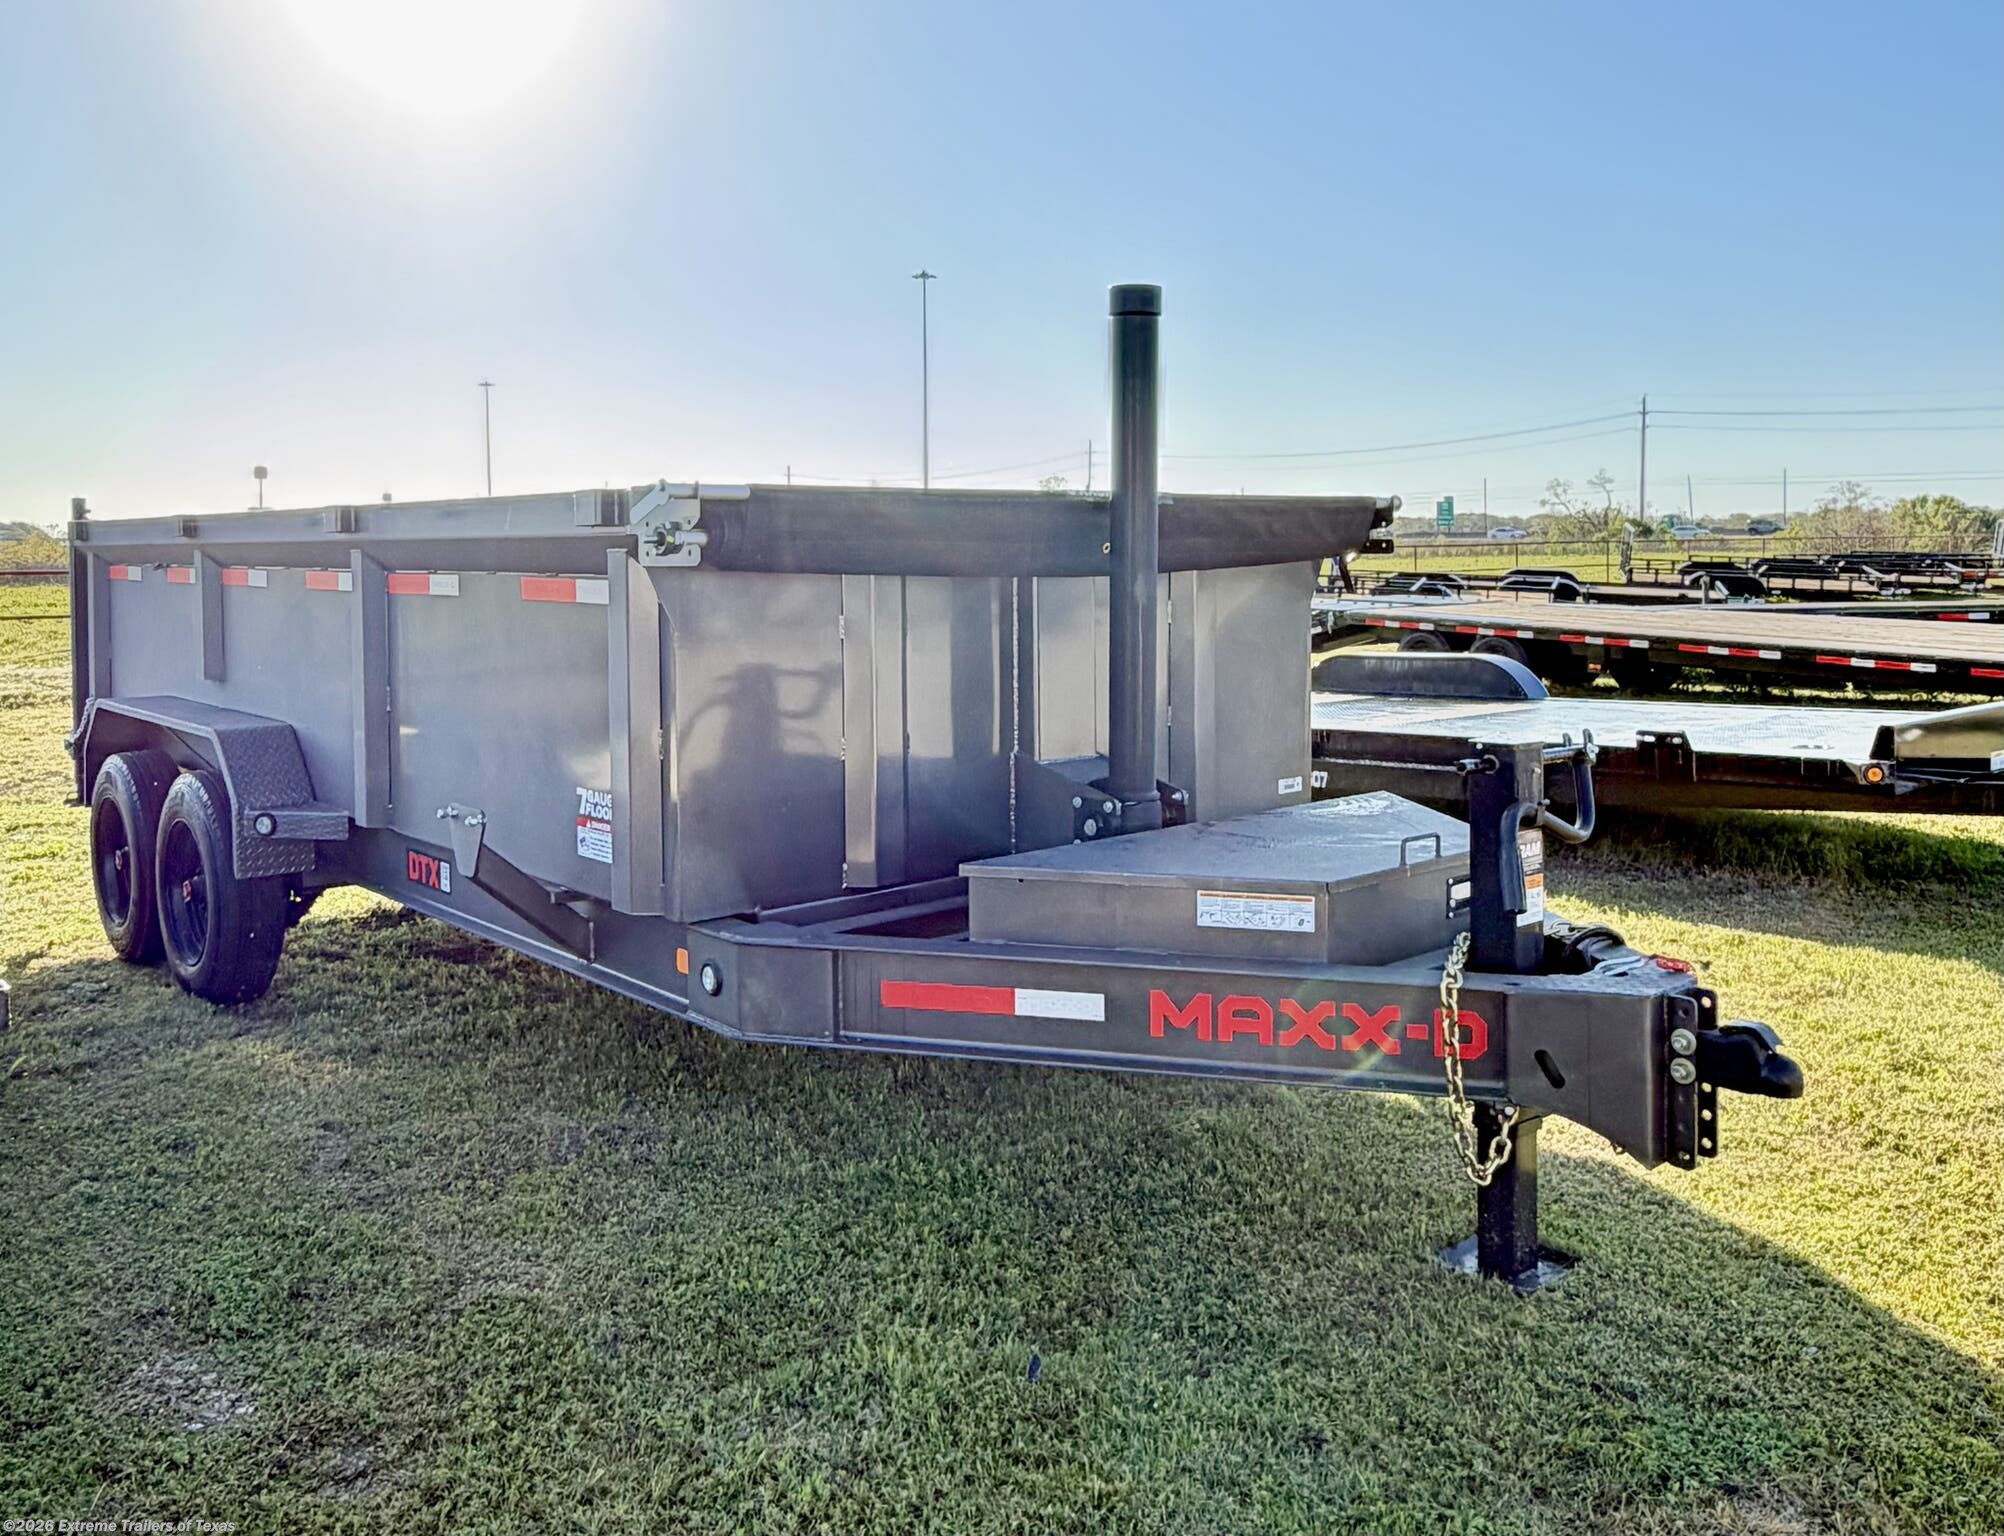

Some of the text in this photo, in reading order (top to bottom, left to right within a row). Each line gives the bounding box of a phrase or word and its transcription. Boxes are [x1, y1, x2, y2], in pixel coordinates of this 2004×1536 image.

[576, 787, 612, 815] 7 GAUG
[408, 850, 439, 889] DTX
[1149, 989, 1488, 1060] MAXX-D
